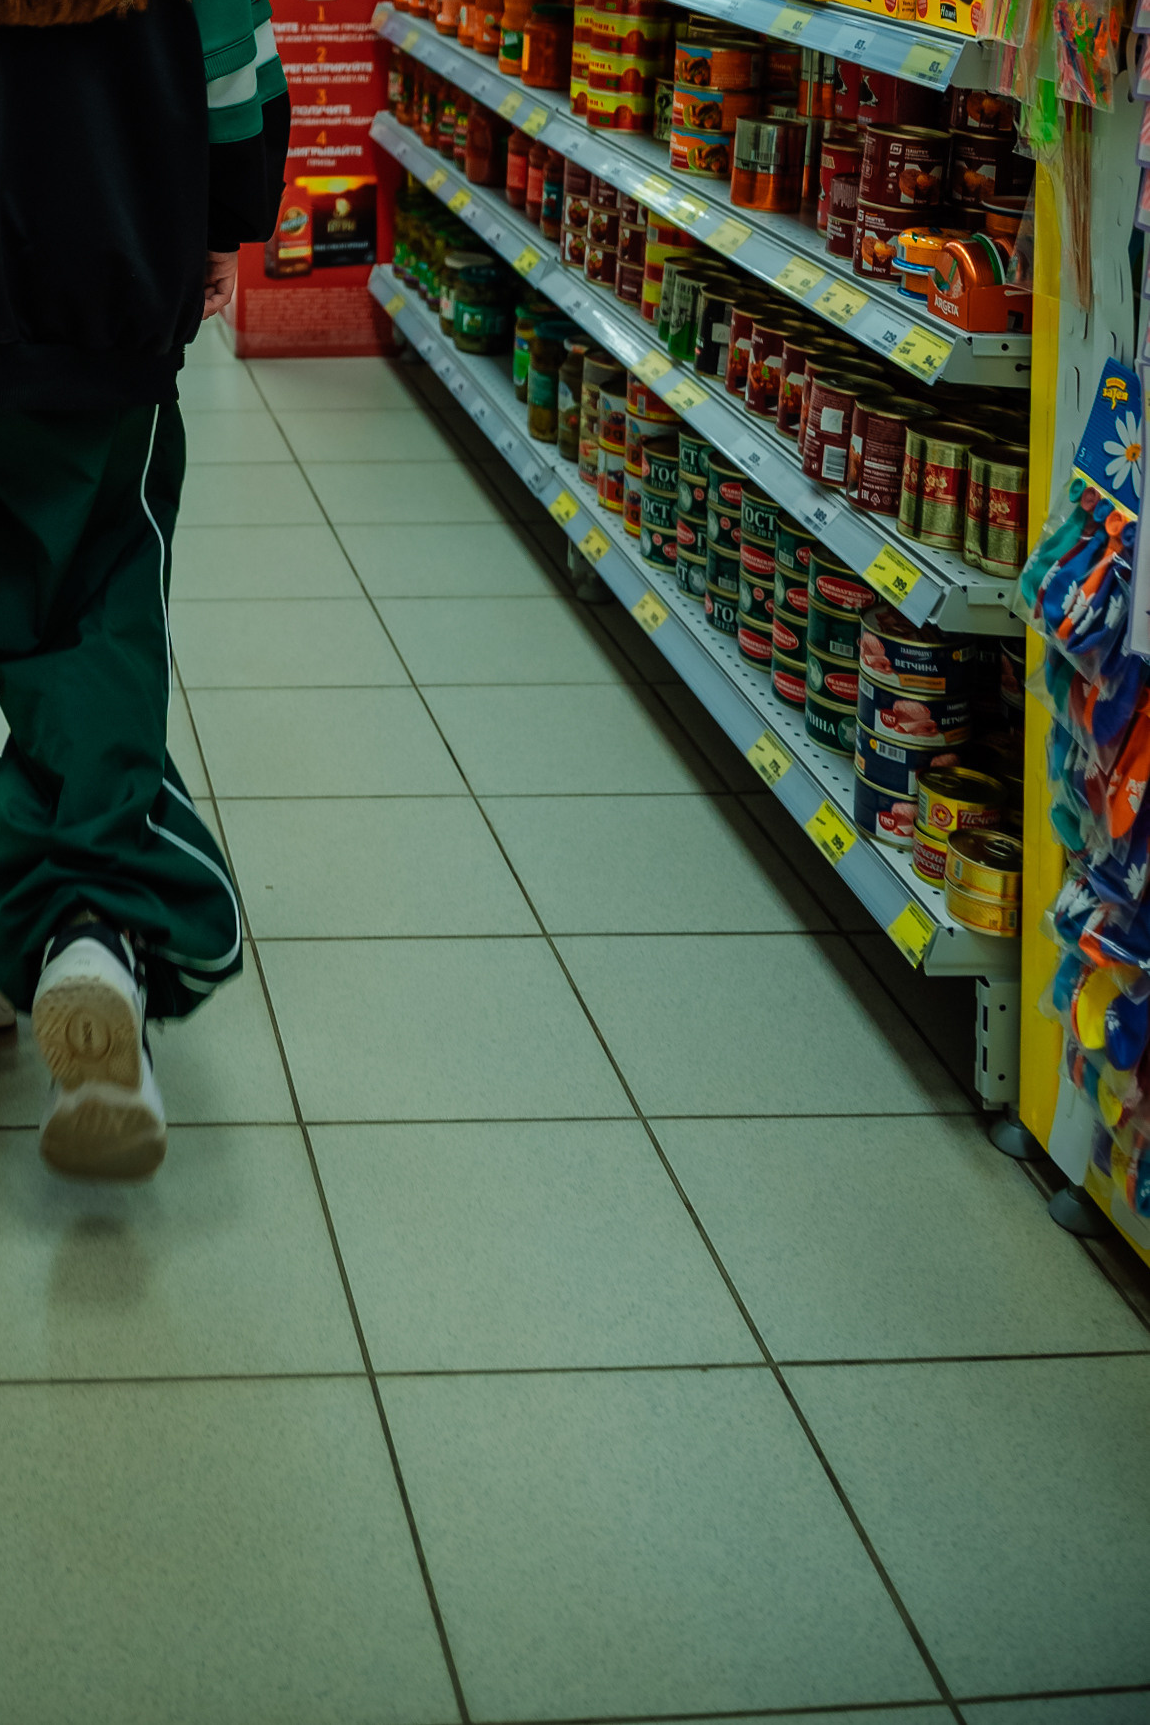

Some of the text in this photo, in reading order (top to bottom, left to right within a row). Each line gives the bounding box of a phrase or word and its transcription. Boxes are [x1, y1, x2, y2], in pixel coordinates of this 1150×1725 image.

[316, 46, 327, 63] 2
[316, 88, 327, 106] 3
[316, 130, 327, 146] 4
[933, 294, 960, 319] ARGETA
[894, 659, 939, 673] ВЕТЧИНА
